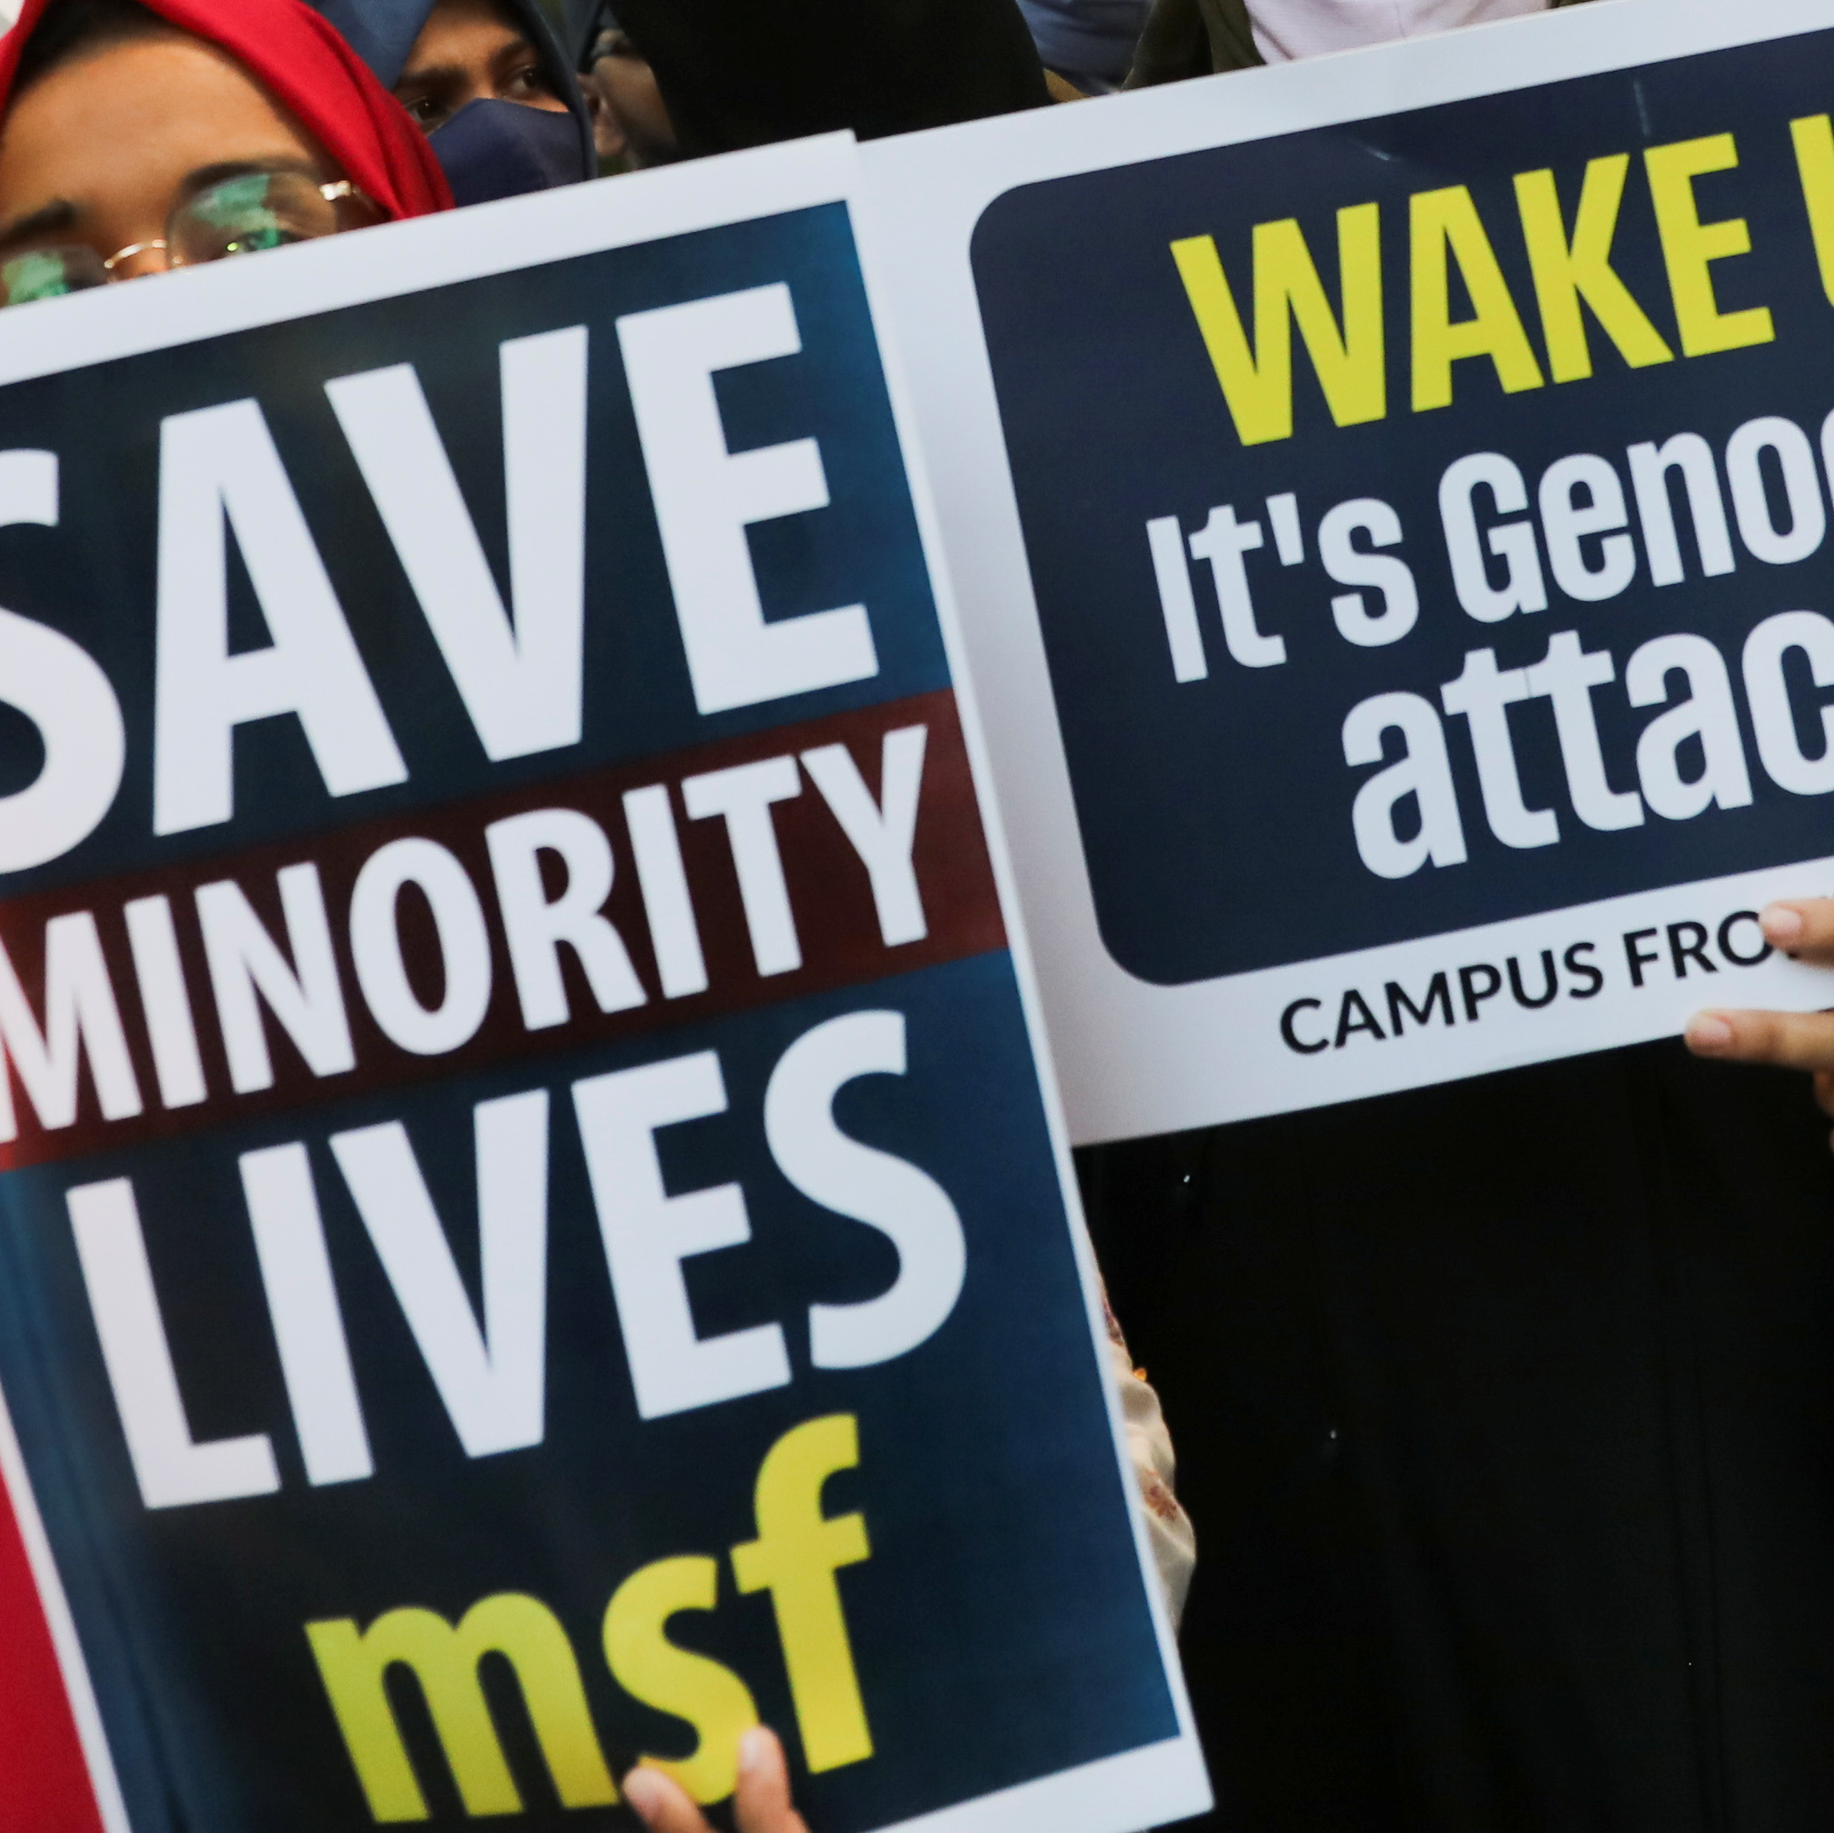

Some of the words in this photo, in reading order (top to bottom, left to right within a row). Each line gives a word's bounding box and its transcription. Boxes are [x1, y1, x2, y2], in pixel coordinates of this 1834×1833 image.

[1171, 131, 1776, 447] WAKE
[1145, 487, 1419, 685] It's
[1279, 940, 1605, 1056] CAMPUS
[65, 1009, 966, 1510] LIVES
[304, 1413, 872, 1822] msf
